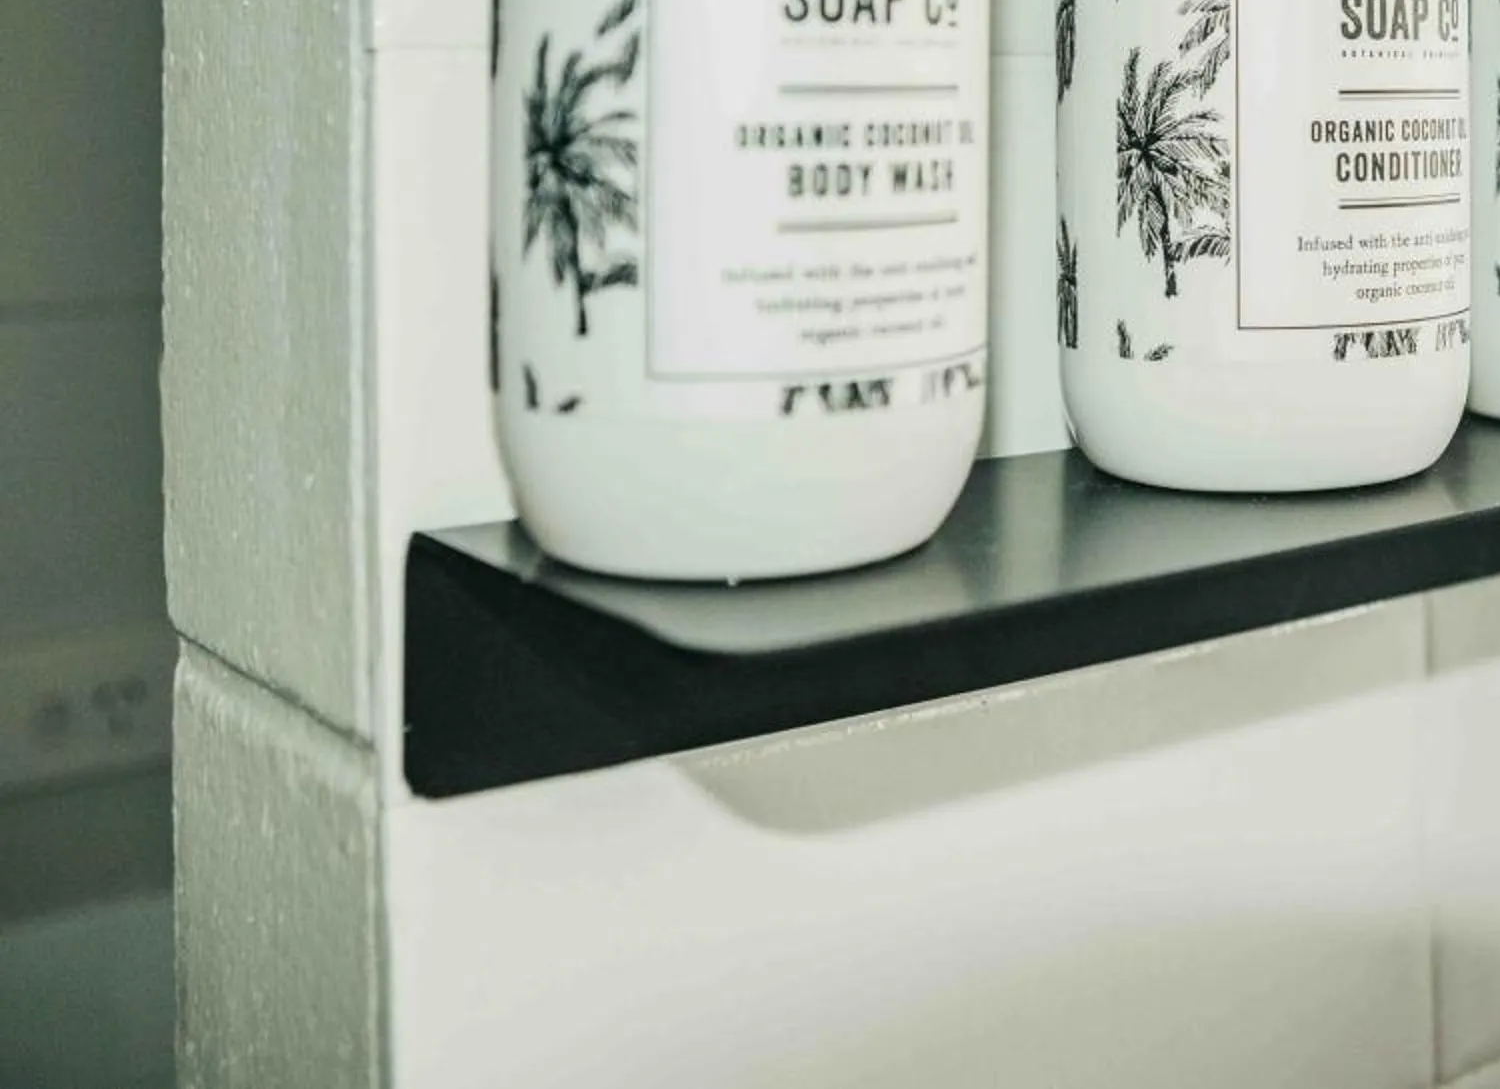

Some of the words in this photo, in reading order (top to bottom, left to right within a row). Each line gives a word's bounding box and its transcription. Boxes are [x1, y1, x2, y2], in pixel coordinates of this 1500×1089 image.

[1311, 119, 1395, 143] ORGANIC
[787, 163, 873, 197] BODY
[1298, 234, 1354, 252] Infused
[1359, 231, 1388, 250] with
[1322, 260, 1390, 281] hydrating
[1356, 281, 1402, 304] organic
